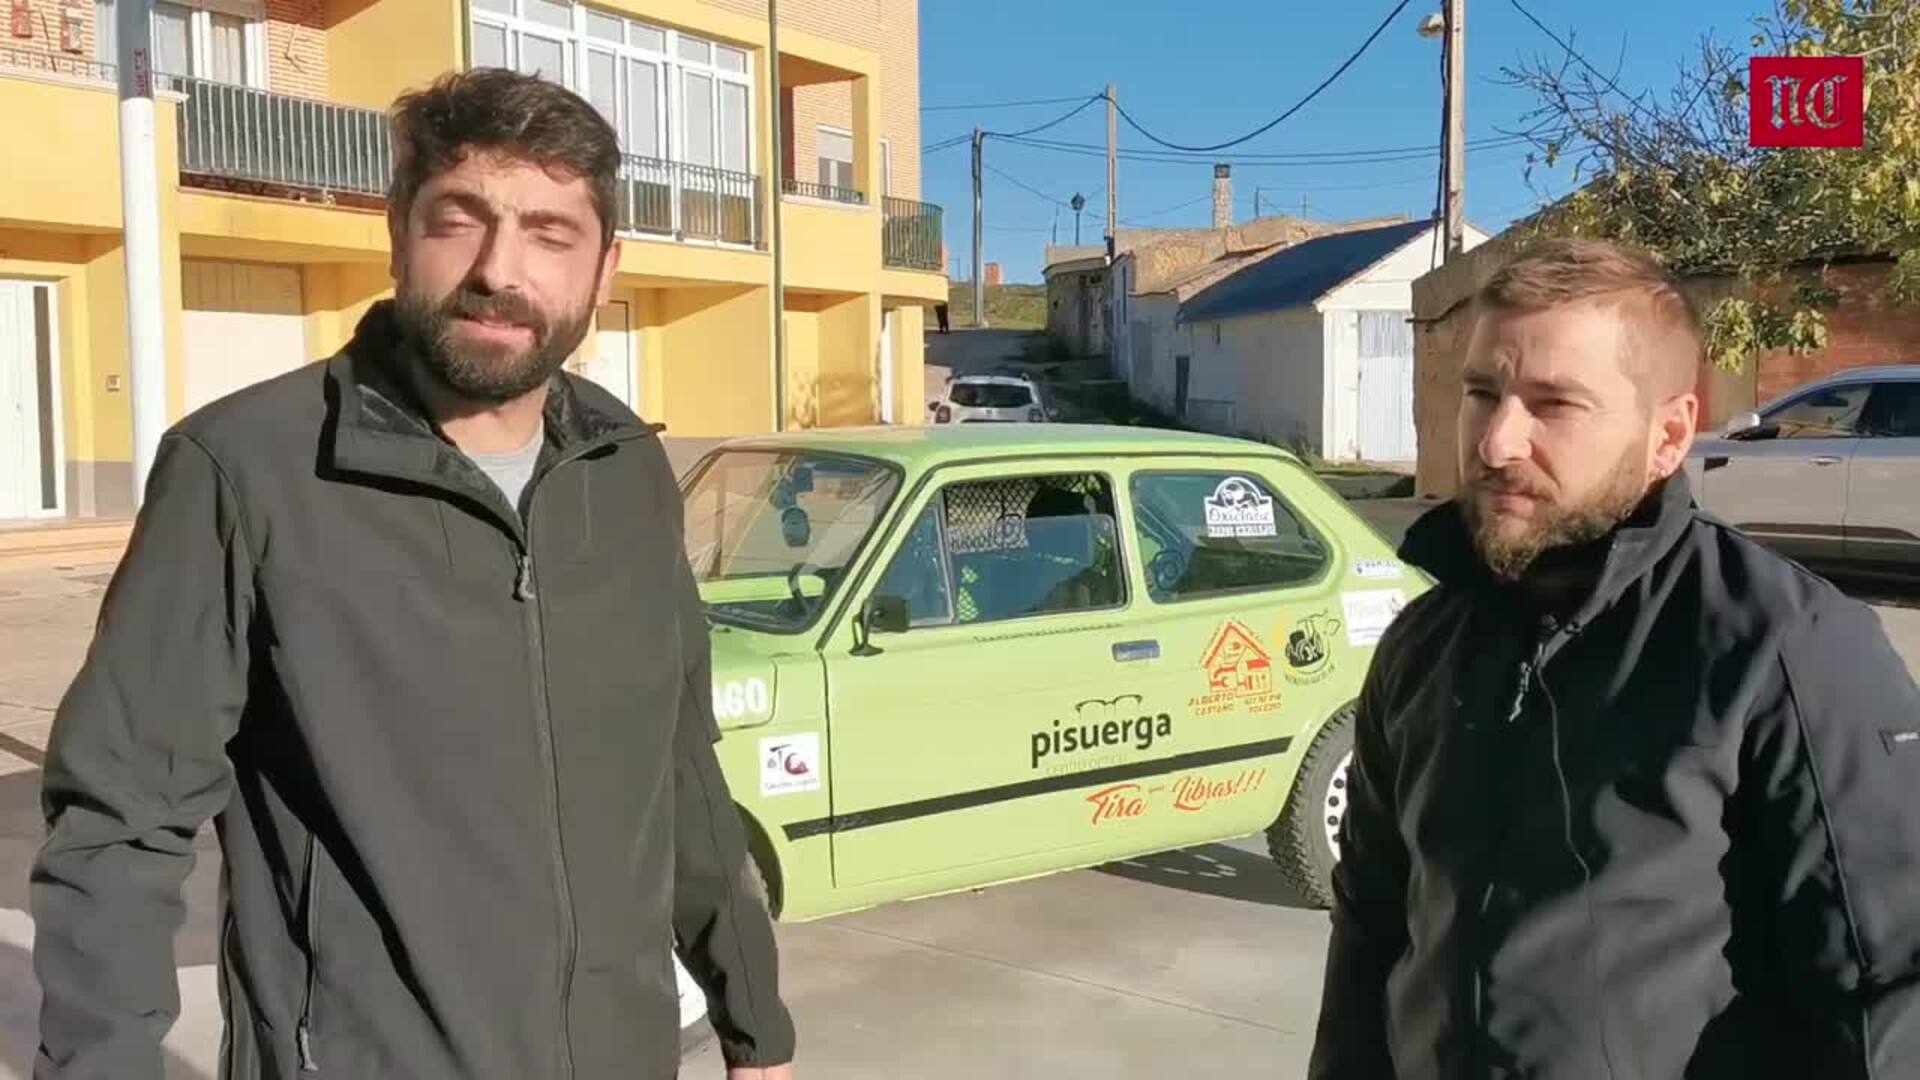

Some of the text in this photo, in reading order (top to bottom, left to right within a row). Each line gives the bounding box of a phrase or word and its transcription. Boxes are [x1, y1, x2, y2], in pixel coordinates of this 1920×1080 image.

[1031, 712, 1172, 769] pisuerga
[1087, 768, 1266, 825] Tira Libras!!!
